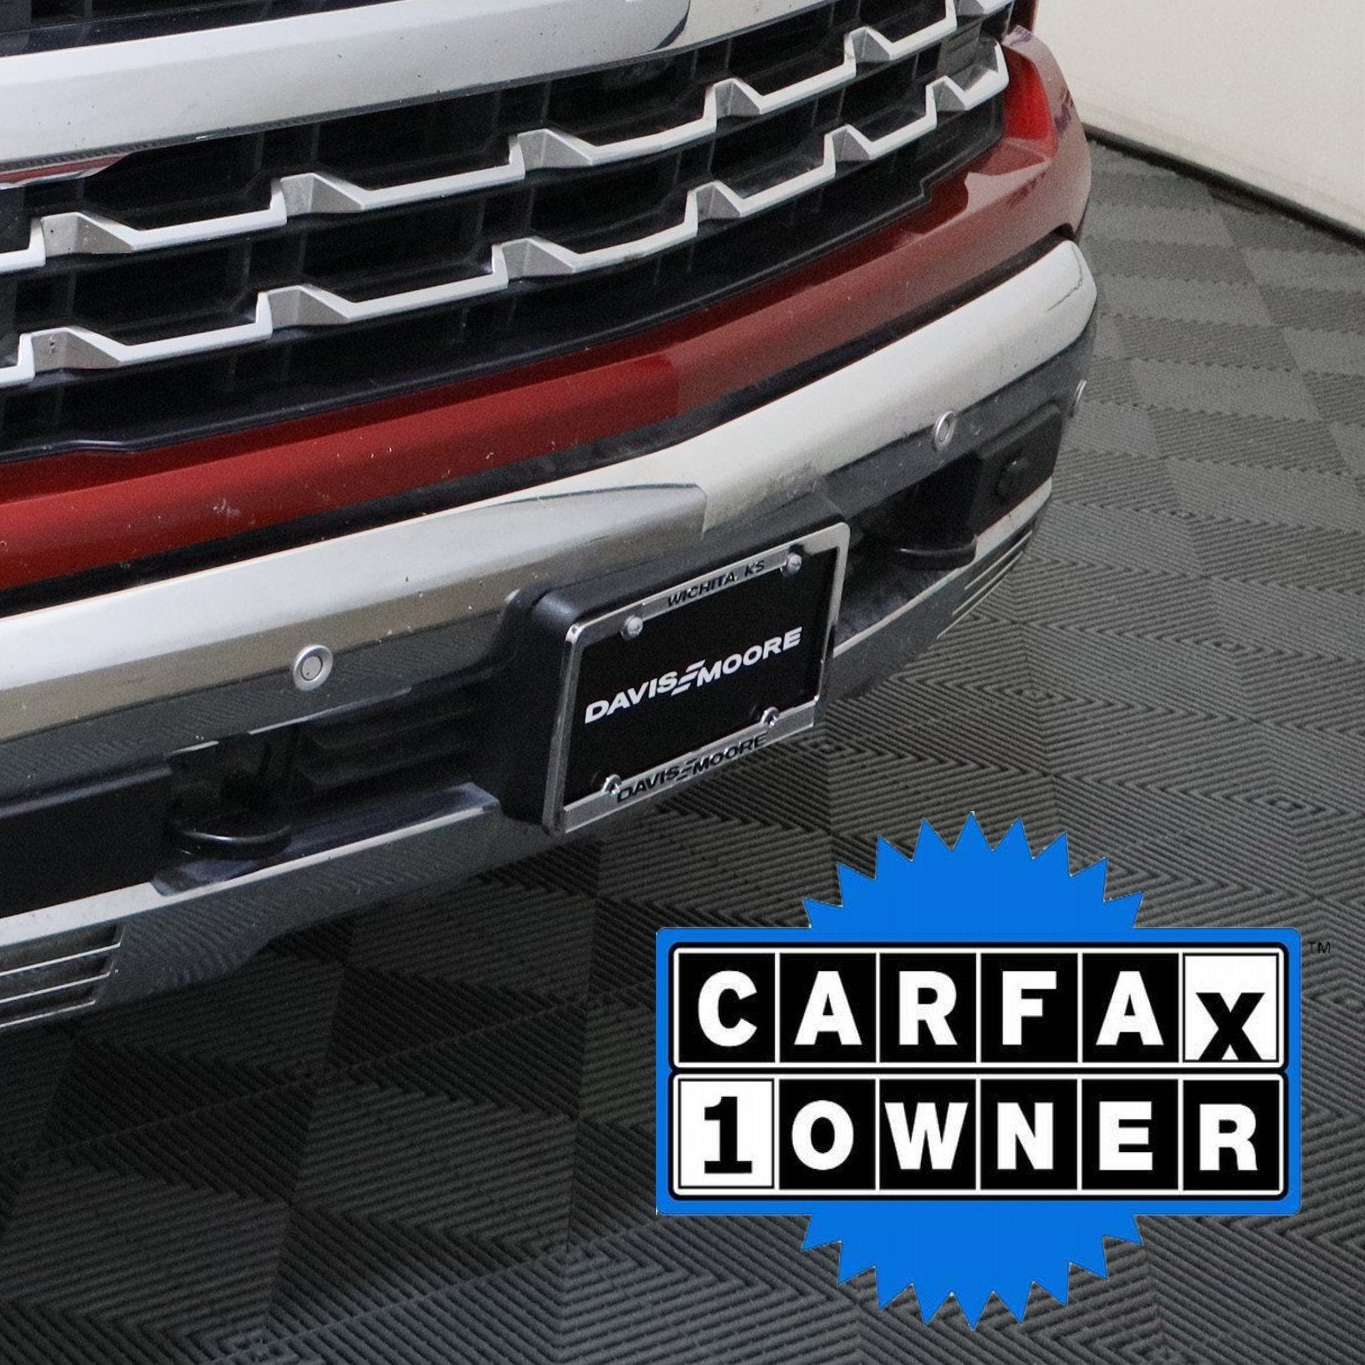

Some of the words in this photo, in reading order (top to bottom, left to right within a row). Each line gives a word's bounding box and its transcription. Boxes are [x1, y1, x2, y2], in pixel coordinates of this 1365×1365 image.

[667, 571, 739, 607] WICHITA,
[744, 560, 765, 577] KS
[584, 672, 678, 724] DAVIS
[696, 626, 803, 688] MOORE
[616, 765, 680, 804] DAVIS
[692, 732, 768, 775] MOORE
